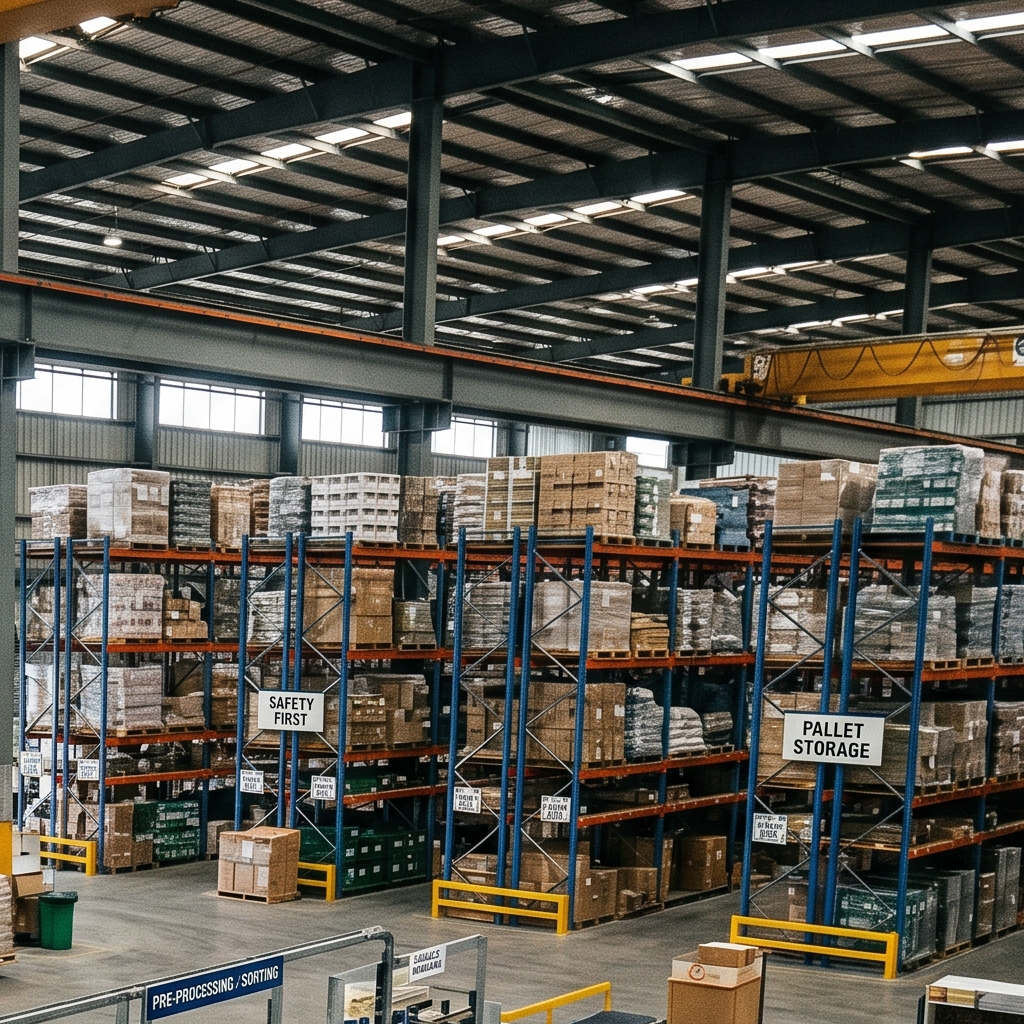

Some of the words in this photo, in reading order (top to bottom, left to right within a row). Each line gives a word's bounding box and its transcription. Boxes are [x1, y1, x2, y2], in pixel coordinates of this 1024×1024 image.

[269, 696, 315, 711] SAFETY
[274, 711, 308, 726] FIRST
[803, 720, 865, 739] PALLET
[793, 739, 871, 759] STORAGE
[152, 976, 234, 1010] PRE-PROCESSING
[235, 975, 241, 989] /
[241, 965, 279, 988] SORTING
